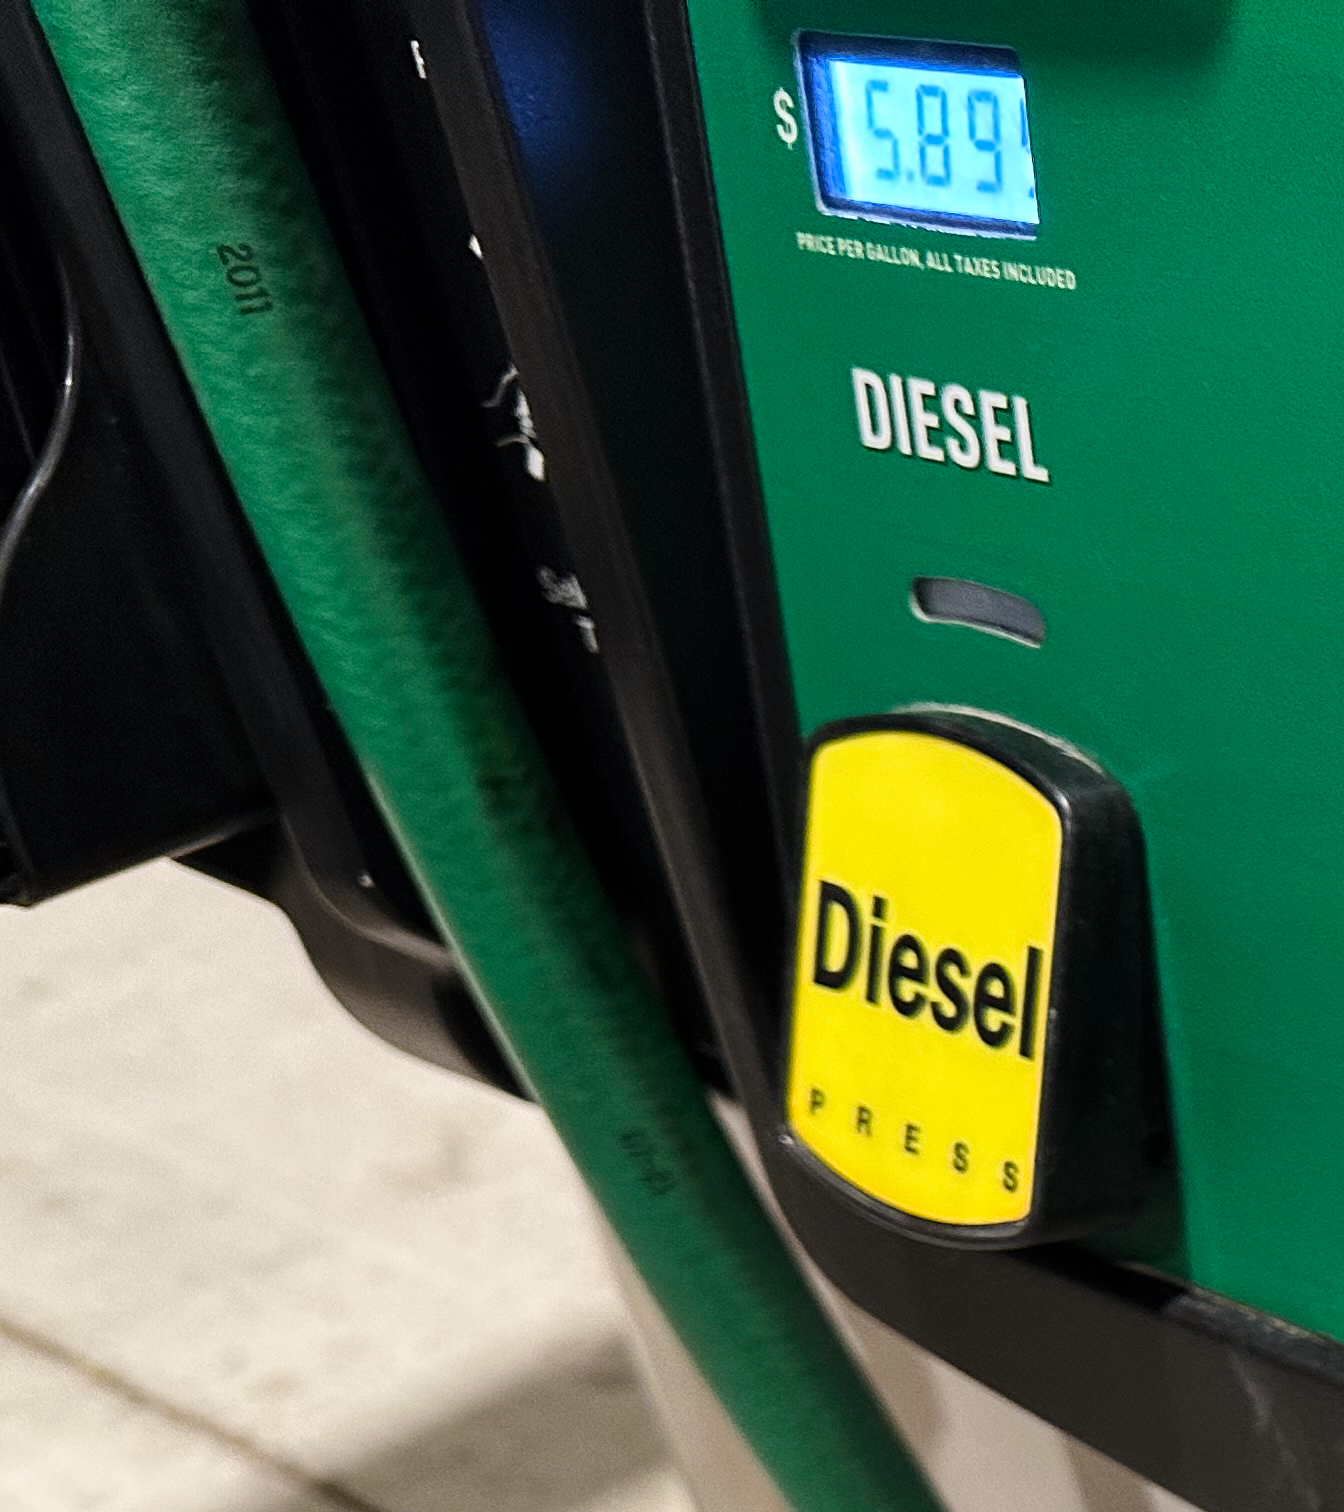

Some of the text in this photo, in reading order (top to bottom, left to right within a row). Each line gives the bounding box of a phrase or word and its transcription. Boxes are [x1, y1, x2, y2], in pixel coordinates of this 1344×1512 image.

[773, 86, 799, 149] $
[216, 242, 274, 315] 2011
[796, 232, 1077, 290] PRICE PER GALLON, ALL TAXES INCLUDED
[851, 366, 1050, 483] DIESEL
[811, 877, 1046, 1063] Diesel
